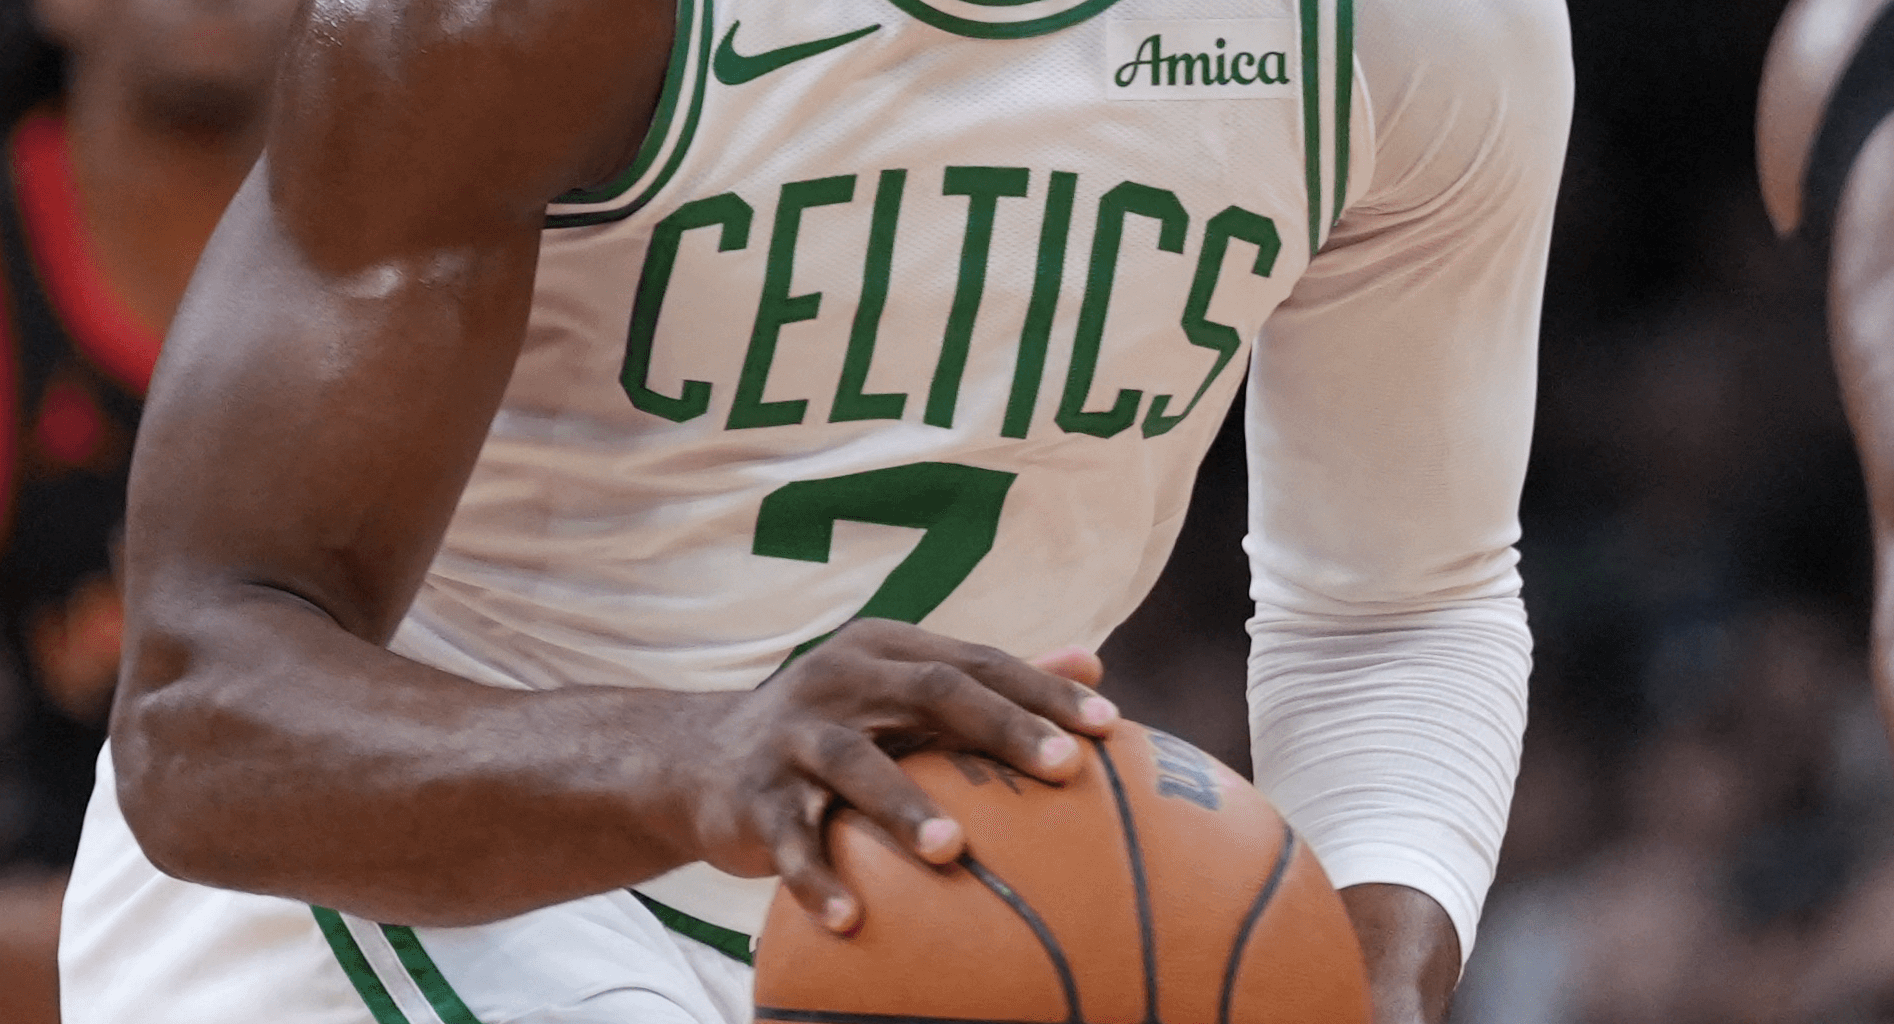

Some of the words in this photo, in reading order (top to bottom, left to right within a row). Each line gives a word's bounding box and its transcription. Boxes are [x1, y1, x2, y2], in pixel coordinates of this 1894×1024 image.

[1114, 33, 1290, 87] Amica
[619, 165, 1282, 440] CELTICS
[751, 461, 1019, 690] 7
